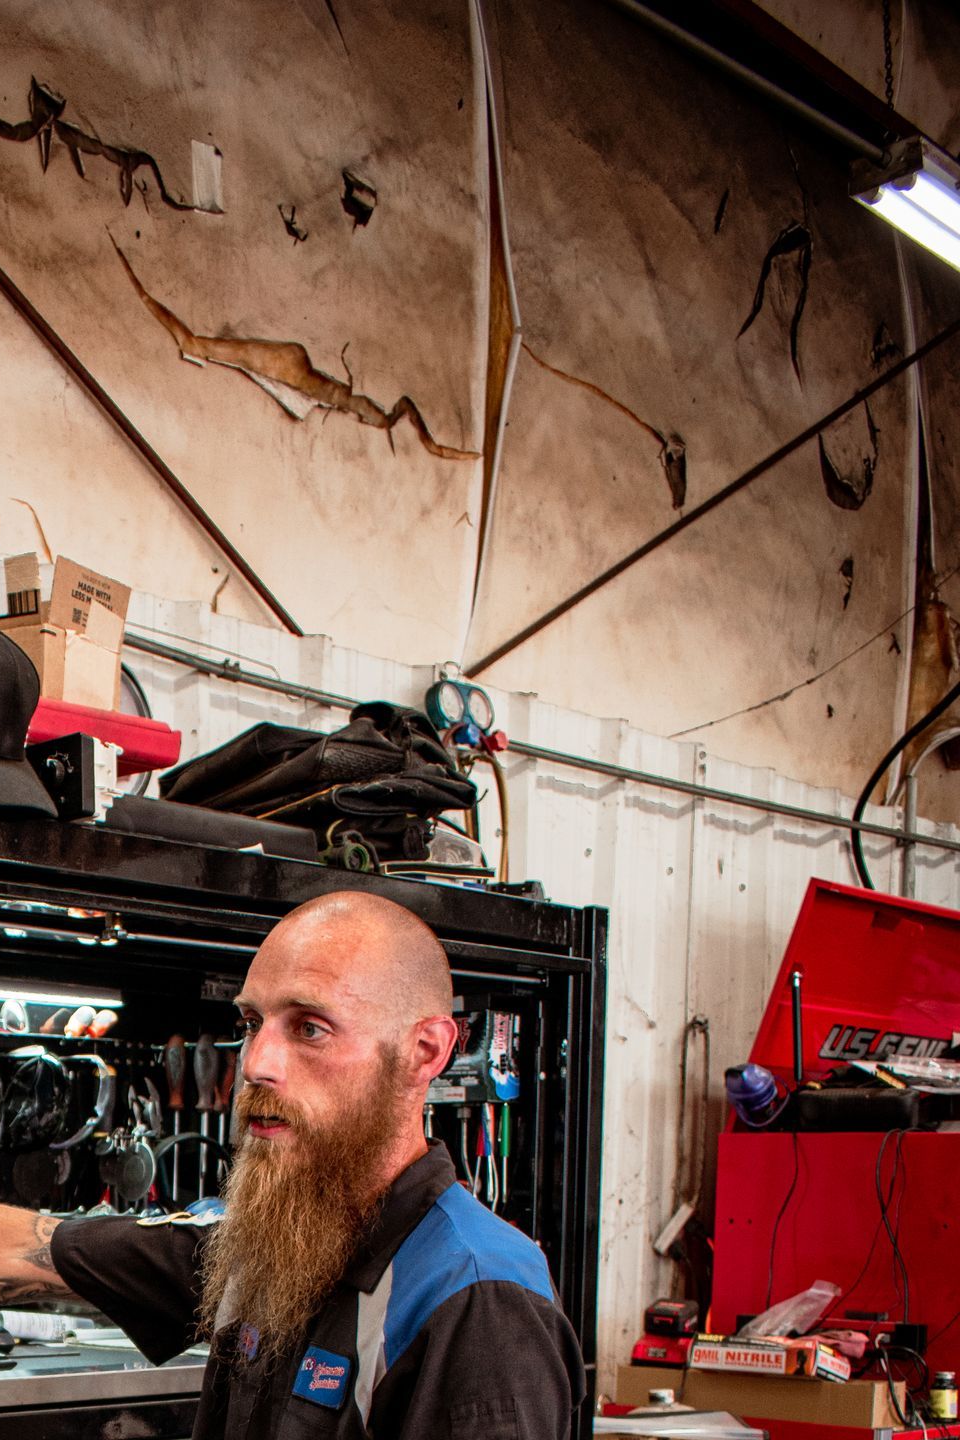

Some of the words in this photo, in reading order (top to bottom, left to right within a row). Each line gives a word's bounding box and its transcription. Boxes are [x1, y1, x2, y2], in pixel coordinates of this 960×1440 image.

[71, 589, 85, 602] LESS
[77, 581, 95, 596] MADE
[95, 588, 111, 602] WITH
[693, 1349, 719, 1363] 9MIL
[724, 1350, 783, 1365] NITRILE
